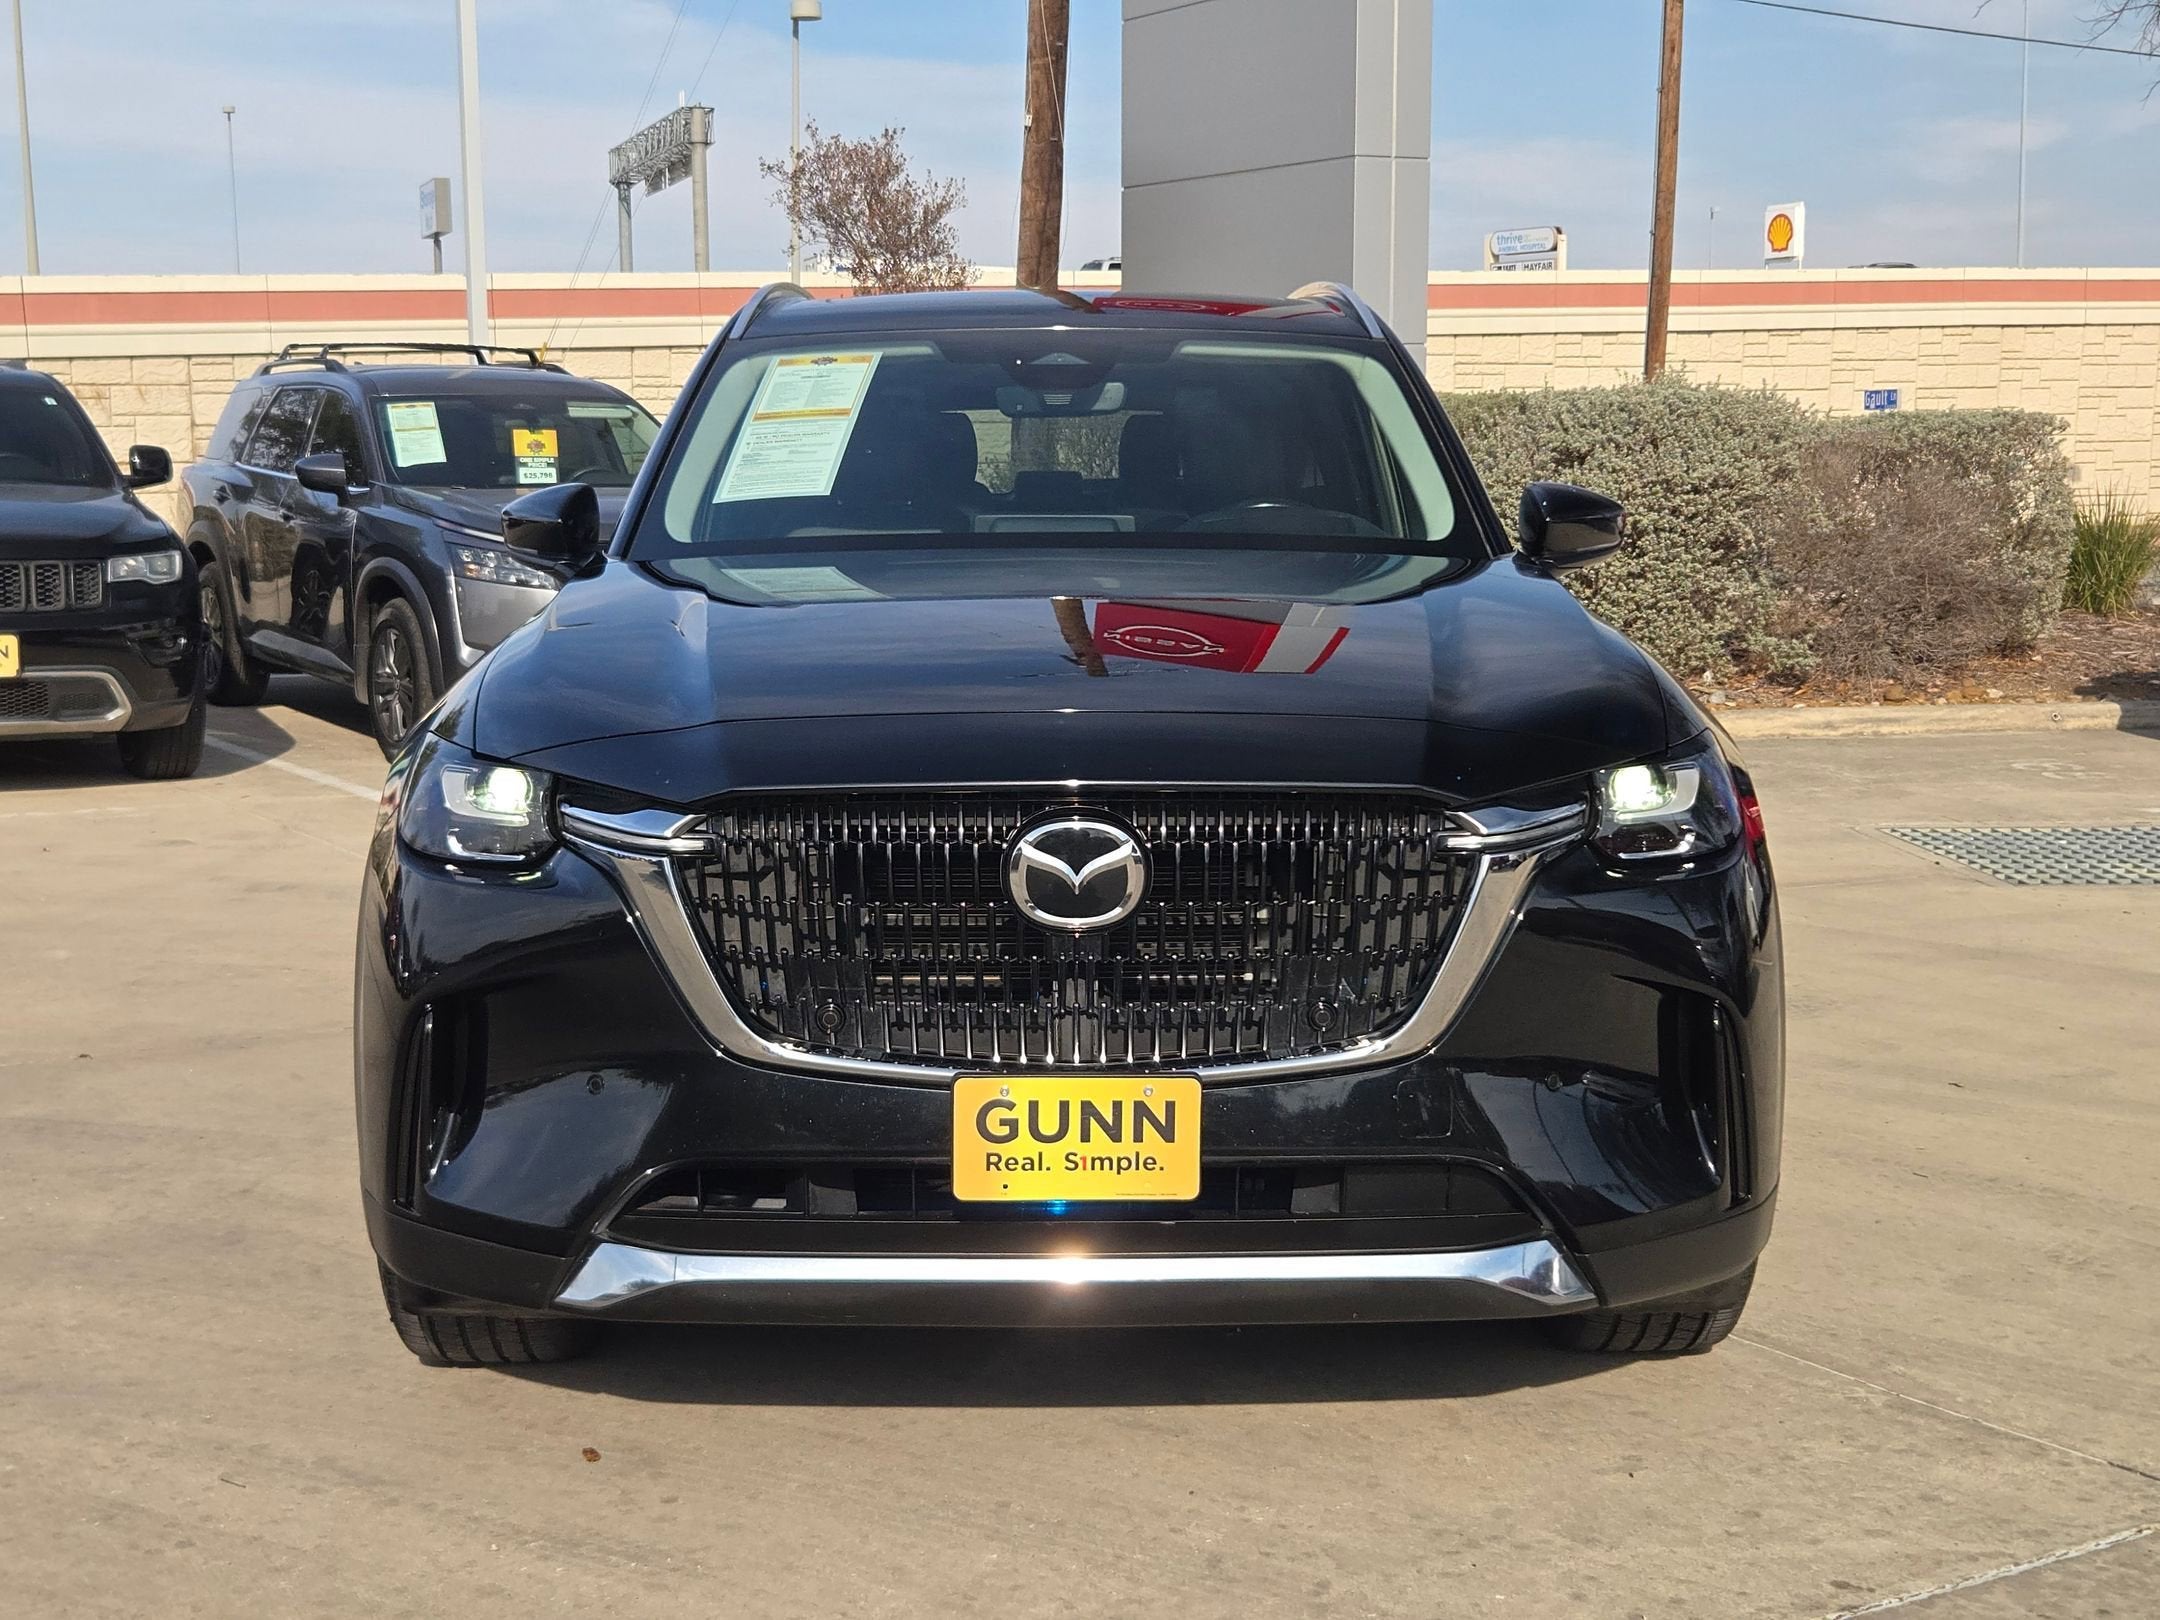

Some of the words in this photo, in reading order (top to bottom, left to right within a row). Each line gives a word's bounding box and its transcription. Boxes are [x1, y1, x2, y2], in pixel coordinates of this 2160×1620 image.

[1497, 232, 1522, 246] thrive
[1523, 262, 1553, 271] MAYFAIR
[976, 1098, 1176, 1144] GUNN
[985, 1151, 1051, 1172] Real.
